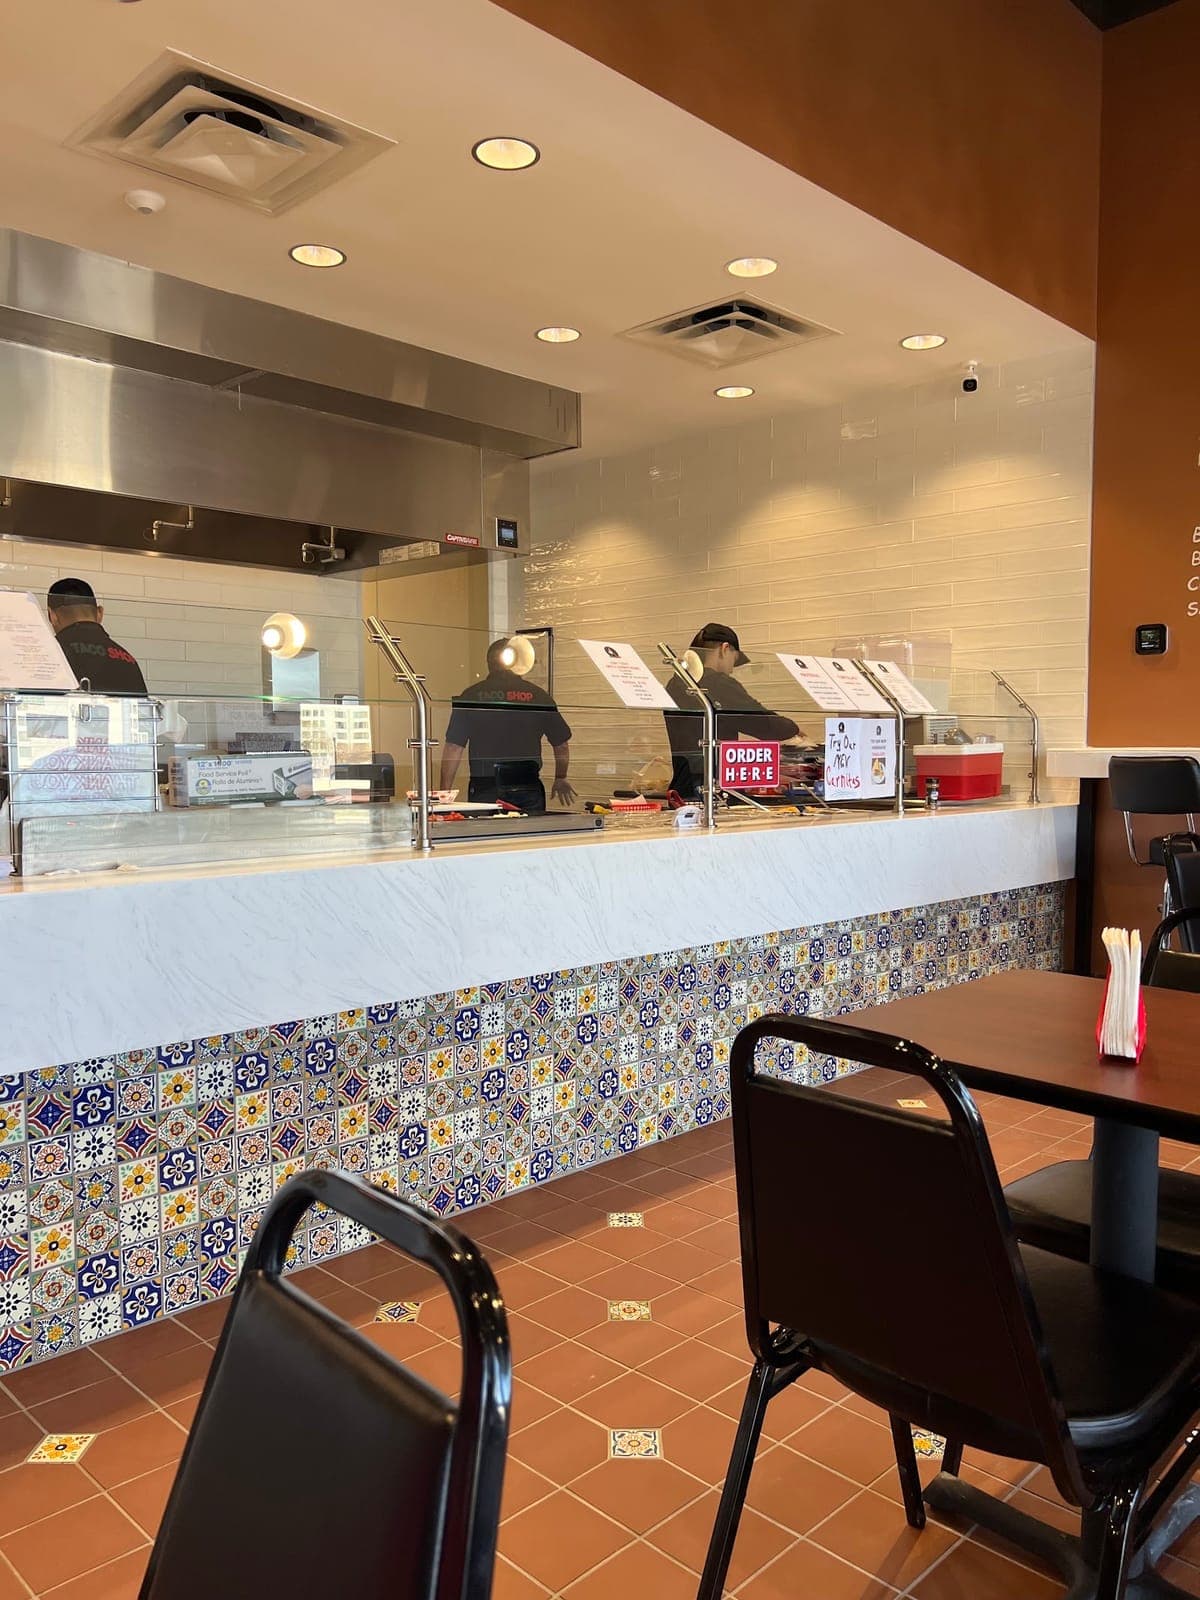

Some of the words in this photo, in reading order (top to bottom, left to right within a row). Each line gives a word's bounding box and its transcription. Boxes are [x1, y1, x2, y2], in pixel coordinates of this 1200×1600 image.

[70, 642, 105, 657] TACO
[506, 690, 533, 702] SHOP
[829, 733, 842, 752] Try
[843, 735, 856, 751] Our
[725, 747, 773, 764] ORDER
